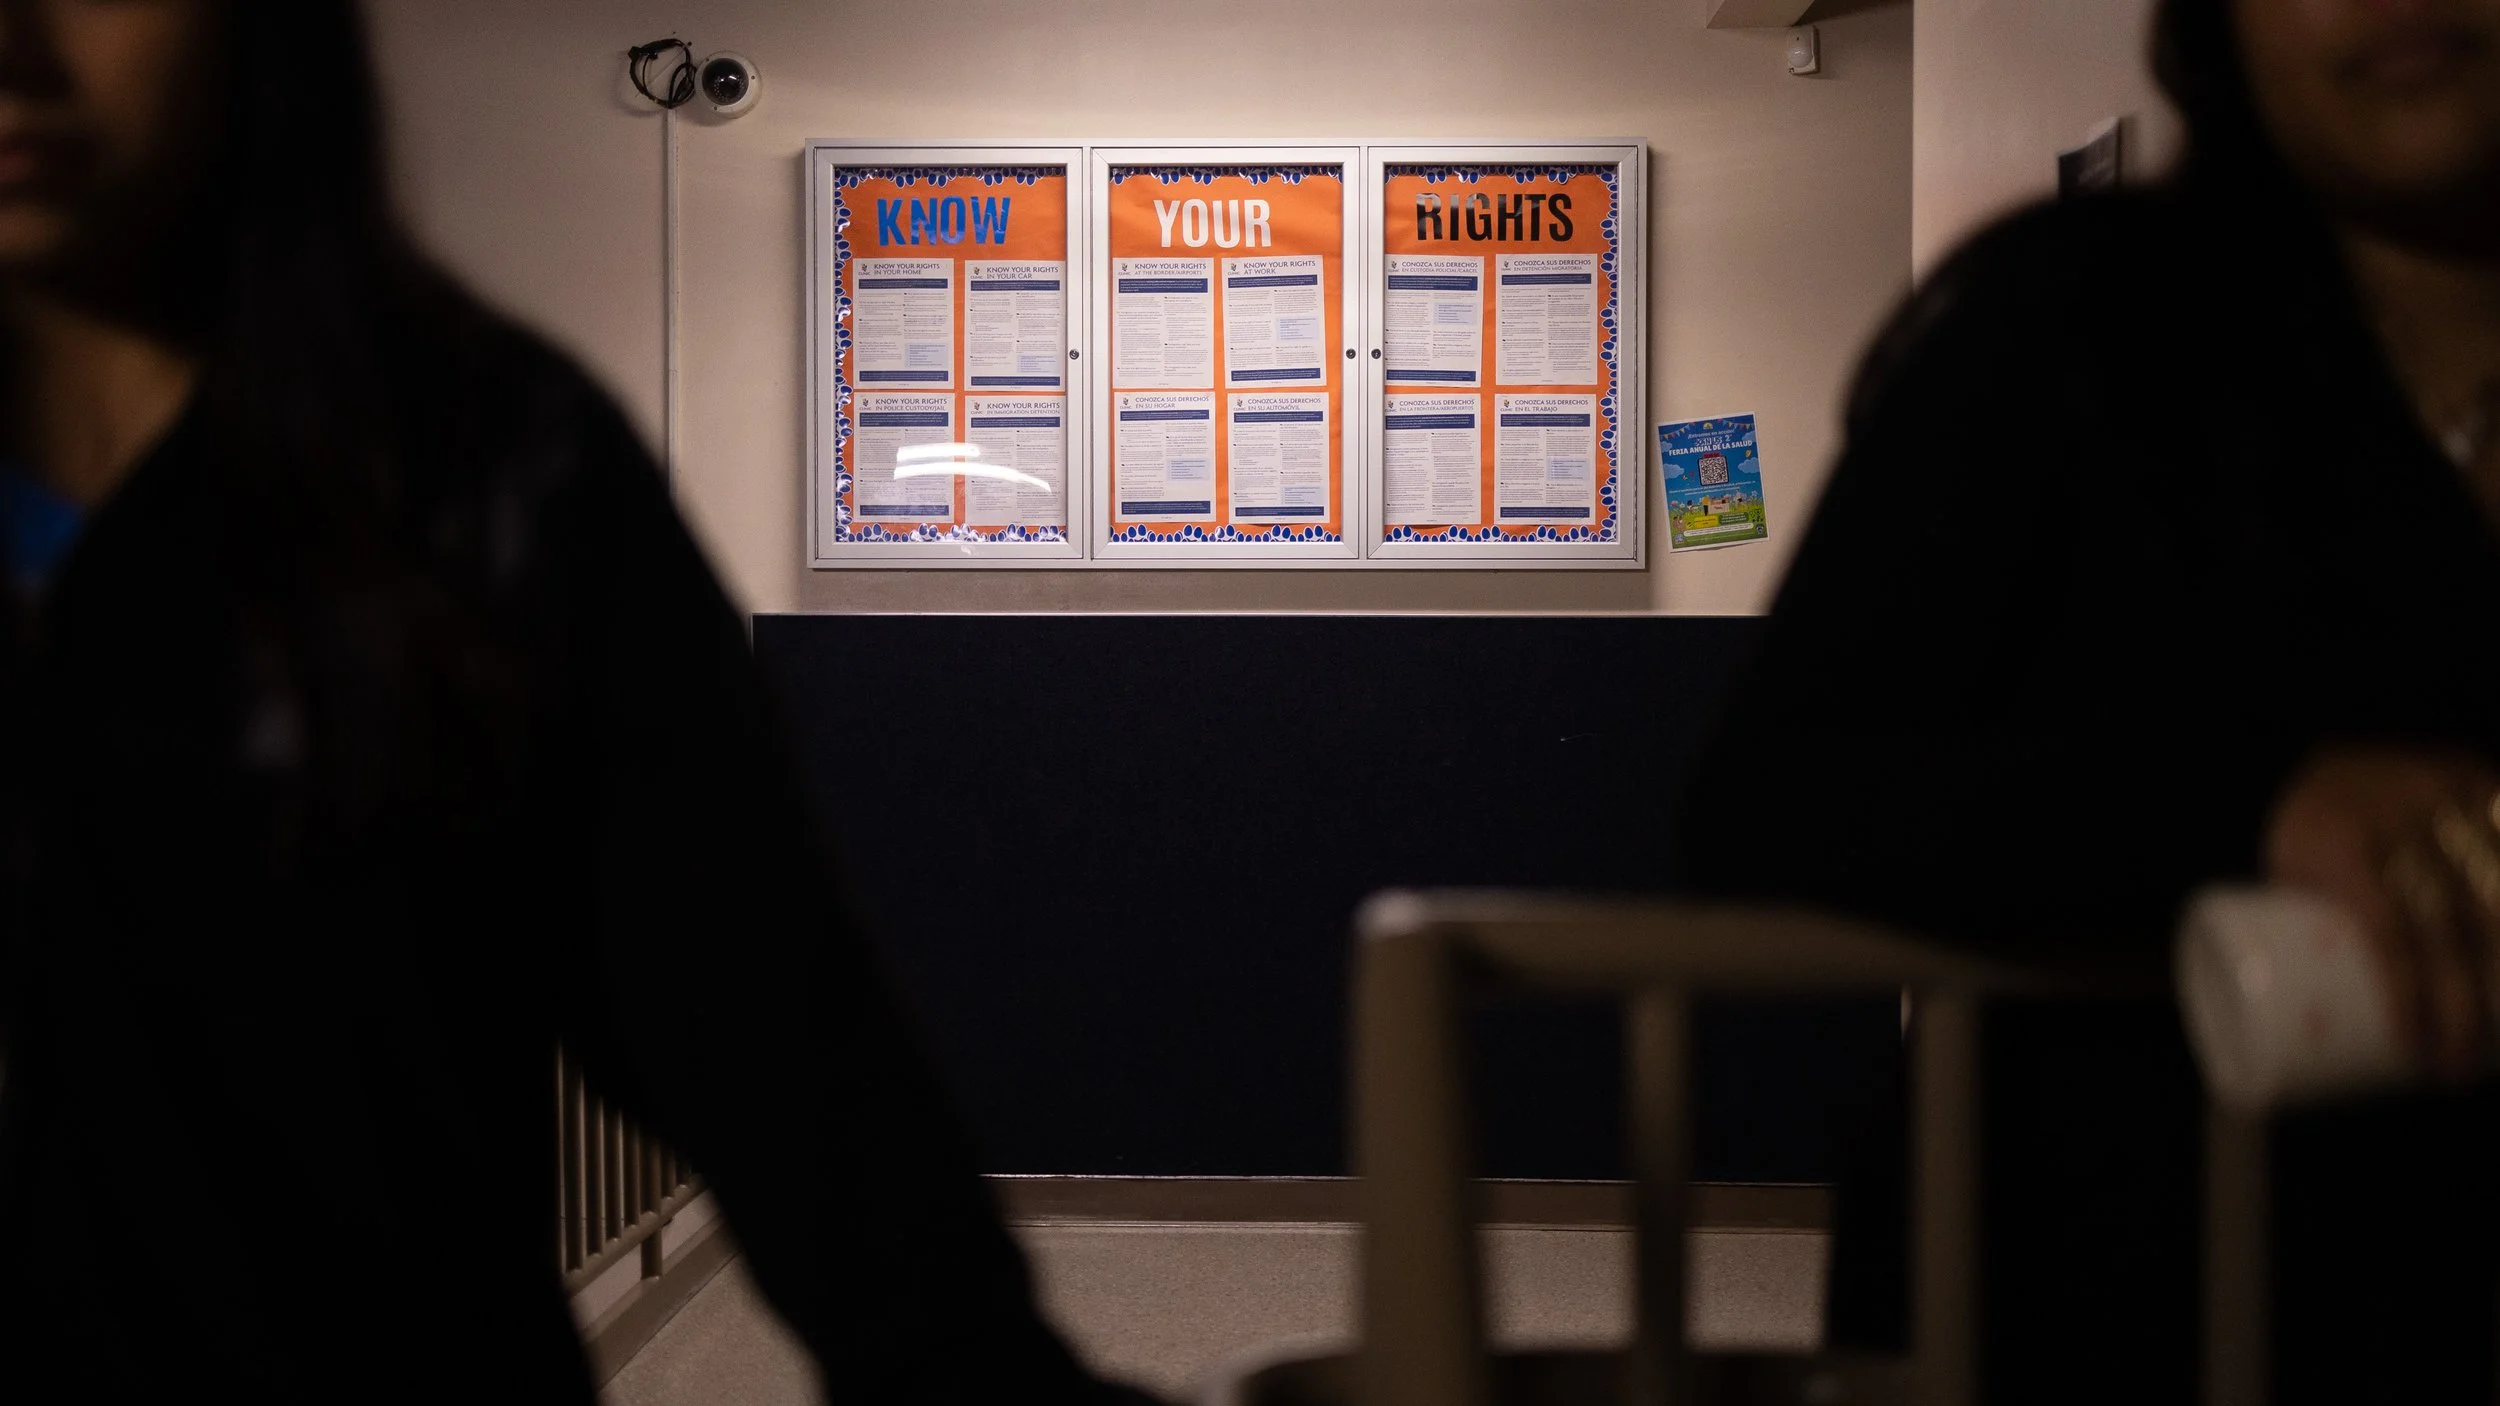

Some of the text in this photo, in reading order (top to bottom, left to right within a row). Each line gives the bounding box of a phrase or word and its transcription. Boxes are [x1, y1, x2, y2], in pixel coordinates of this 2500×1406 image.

[877, 193, 1574, 248] KNOW YOUR RIGHTS
[1668, 447, 1689, 456] FERIA
[1689, 445, 1712, 453] ANUAL
[1731, 440, 1753, 448] SALUD
